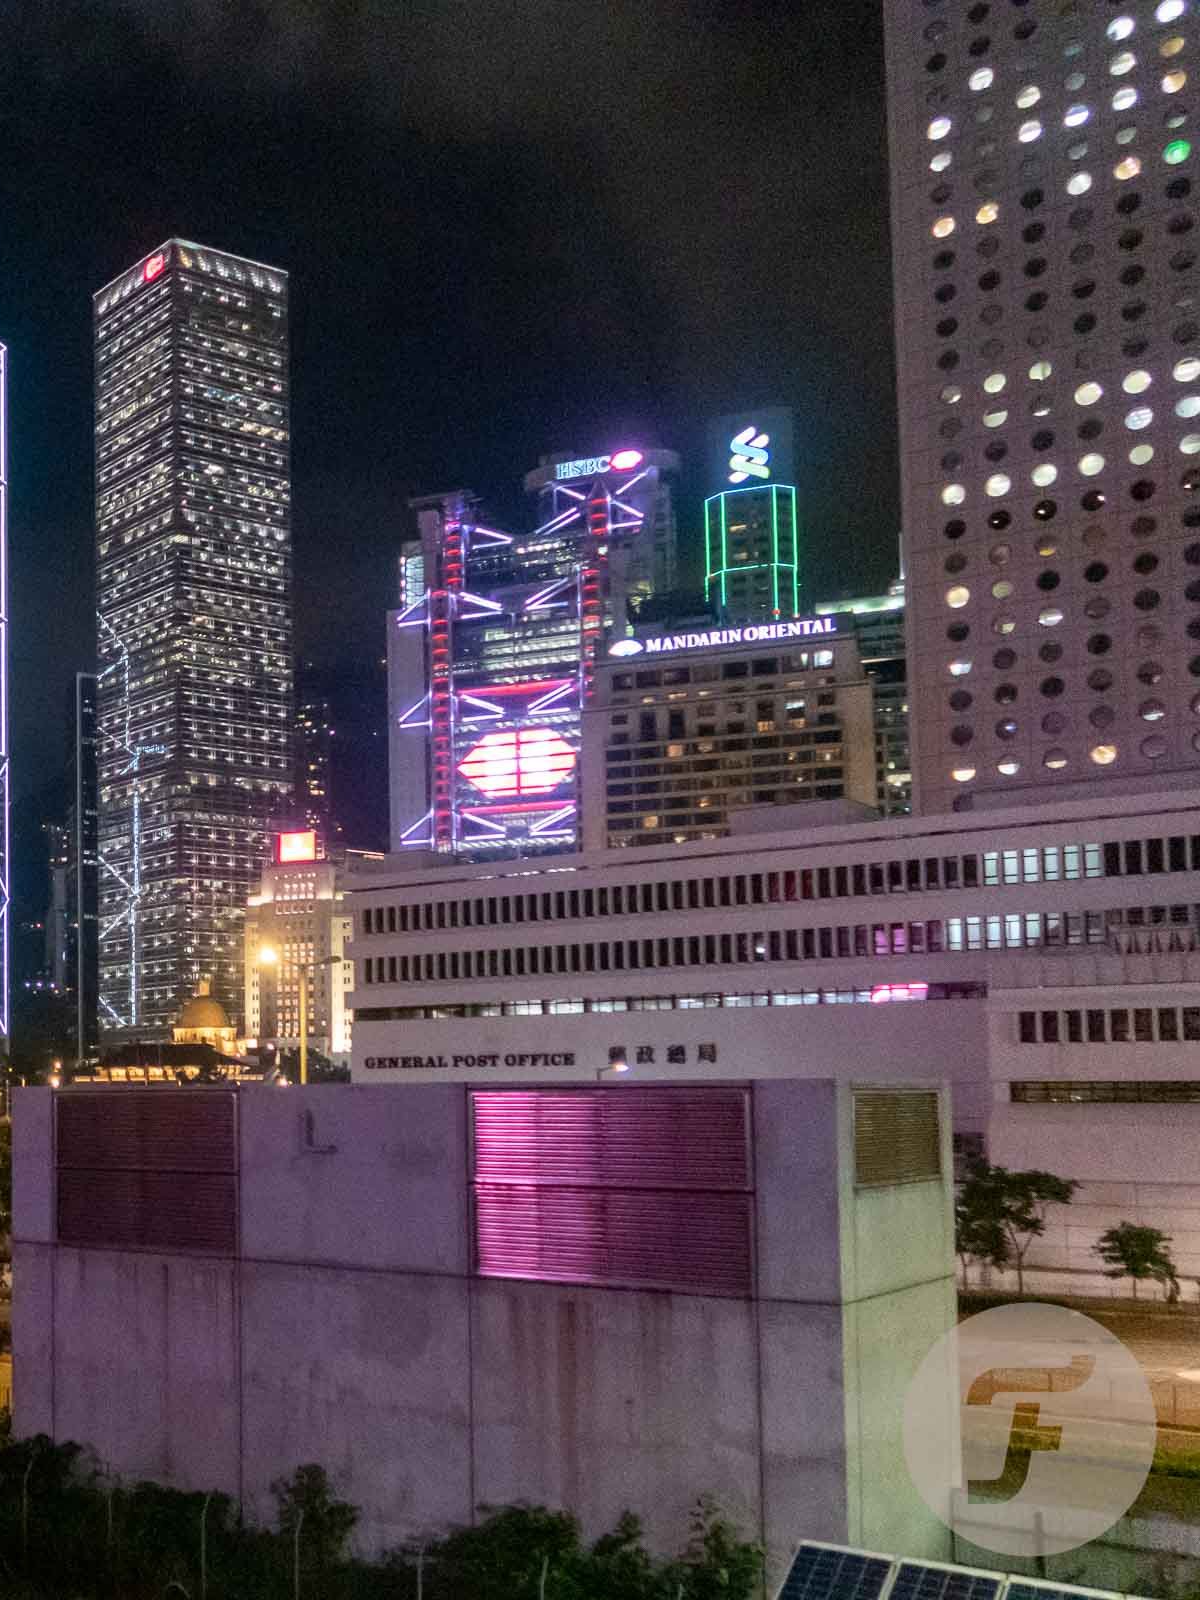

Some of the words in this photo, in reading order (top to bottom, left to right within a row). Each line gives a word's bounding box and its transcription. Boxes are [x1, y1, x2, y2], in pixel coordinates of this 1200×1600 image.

[555, 455, 612, 480] HSBC
[645, 628, 741, 653] MANDARIN
[743, 617, 837, 642] ORIENTAL
[364, 1055, 449, 1069] GENERAL
[452, 1054, 500, 1068] POST
[503, 1053, 576, 1067] OFFICE
